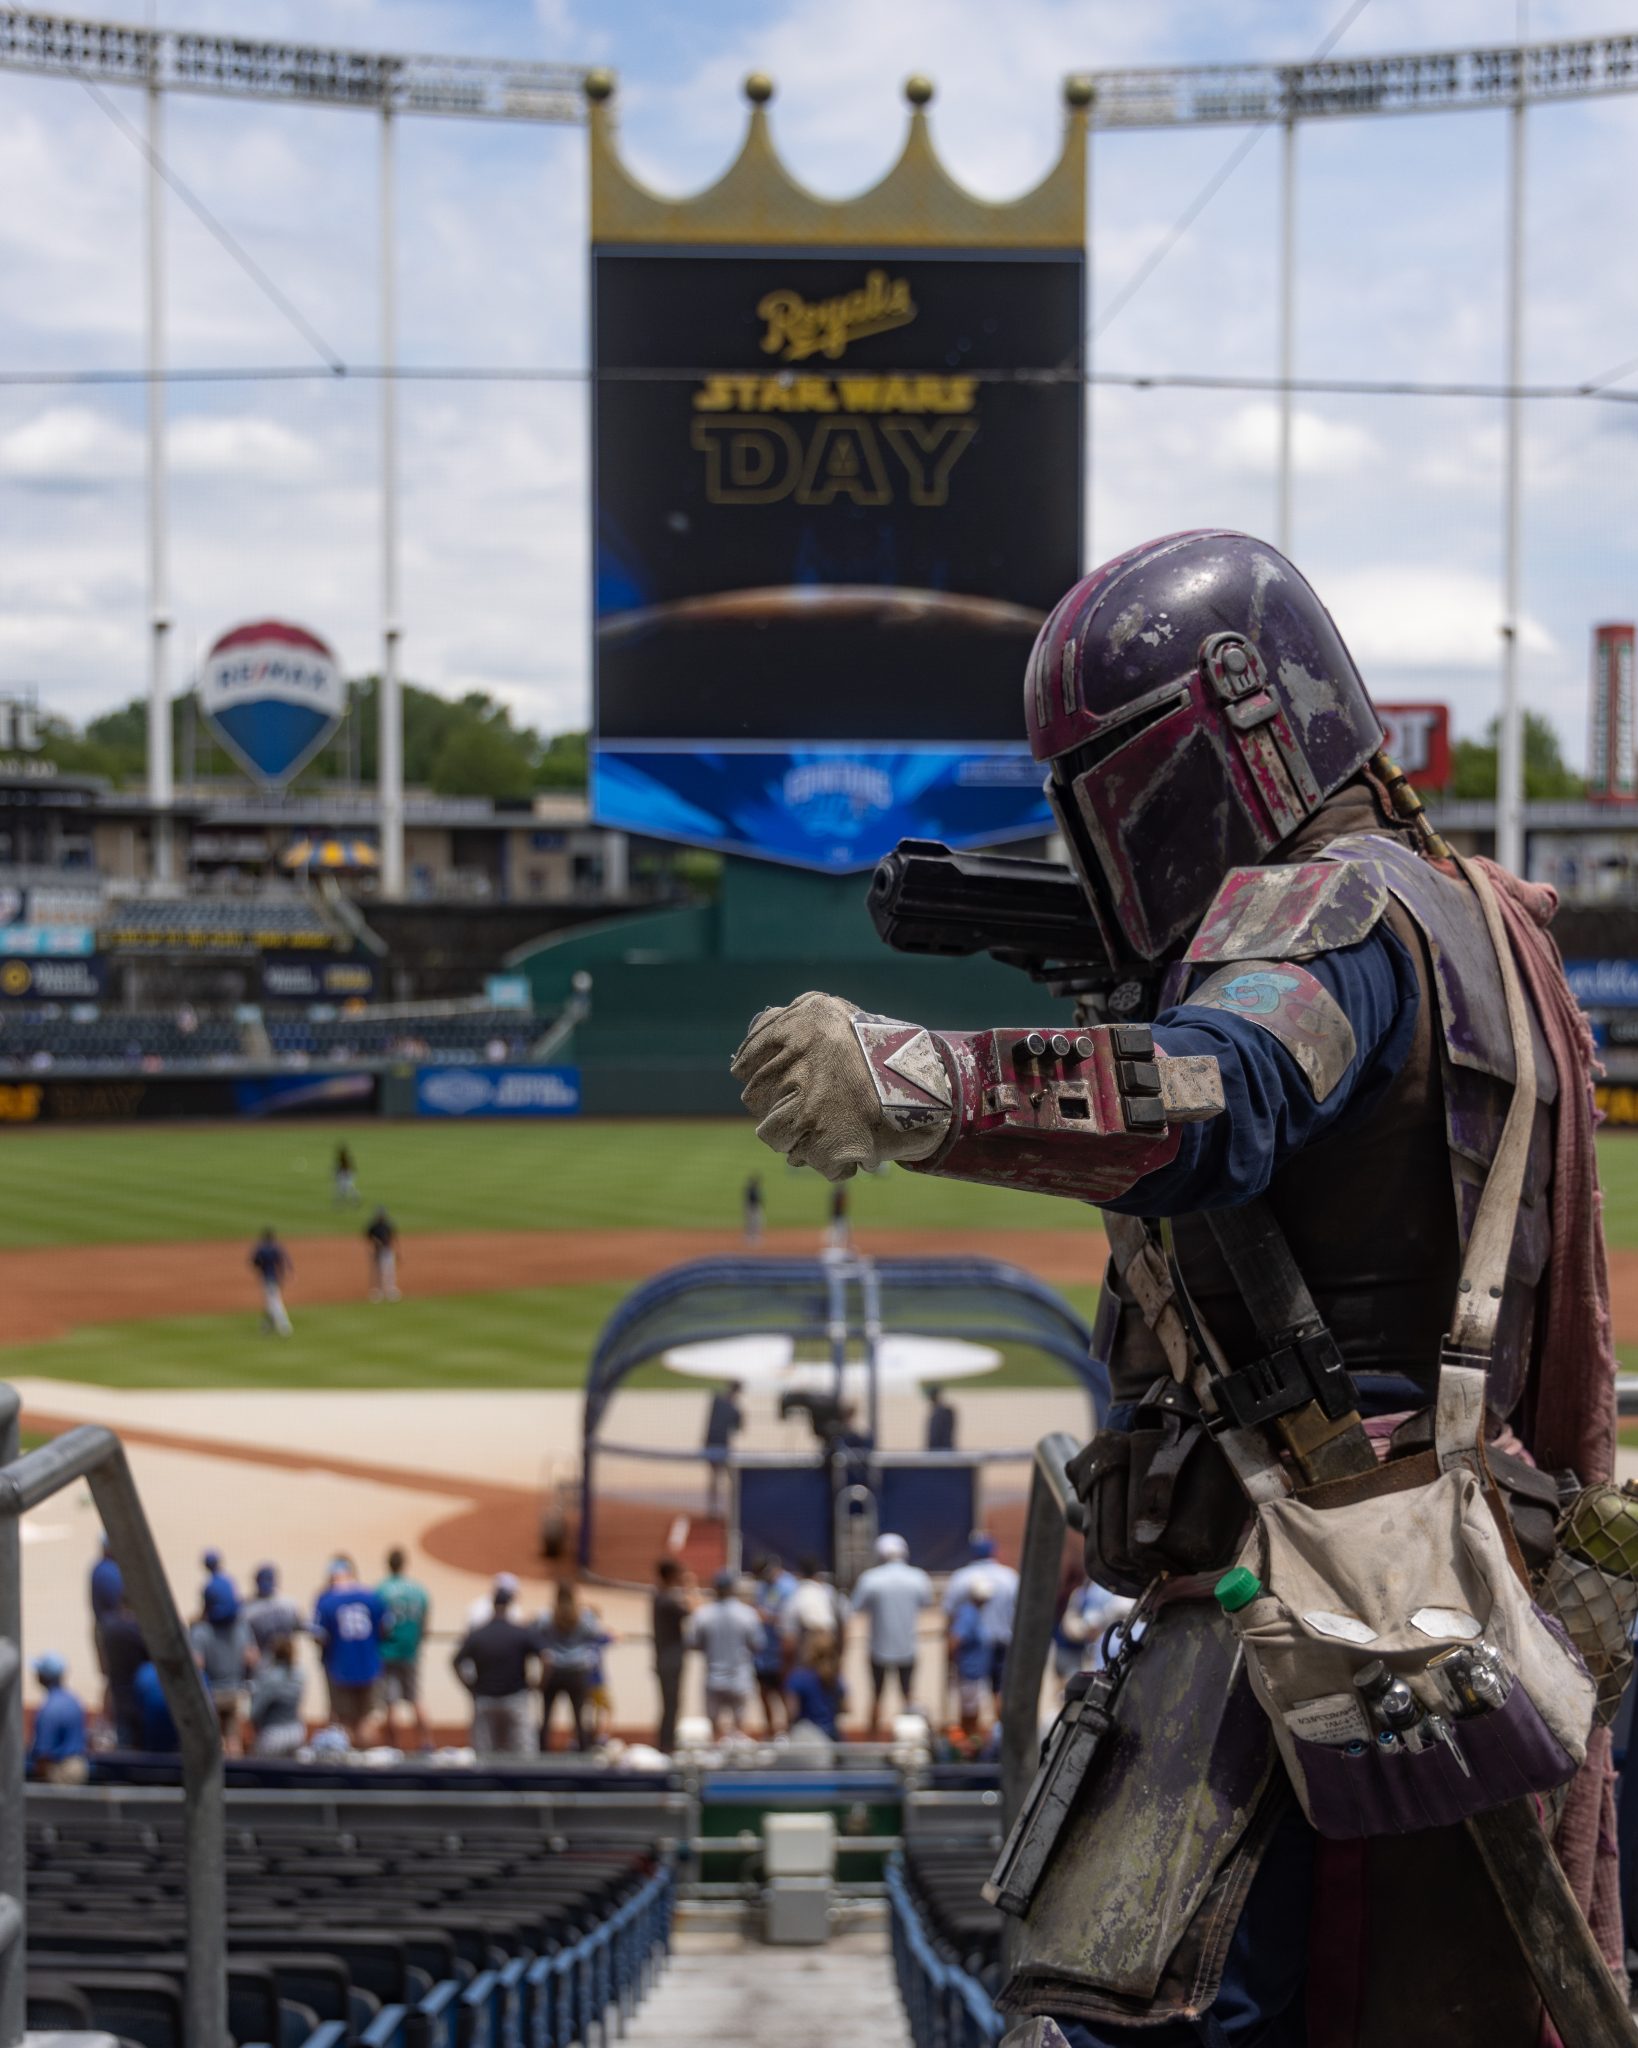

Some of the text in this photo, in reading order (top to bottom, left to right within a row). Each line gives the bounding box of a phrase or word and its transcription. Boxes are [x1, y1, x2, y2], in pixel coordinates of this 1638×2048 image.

[758, 271, 916, 359] Royals
[695, 375, 979, 412] STAR WARS
[691, 415, 979, 506] DAY
